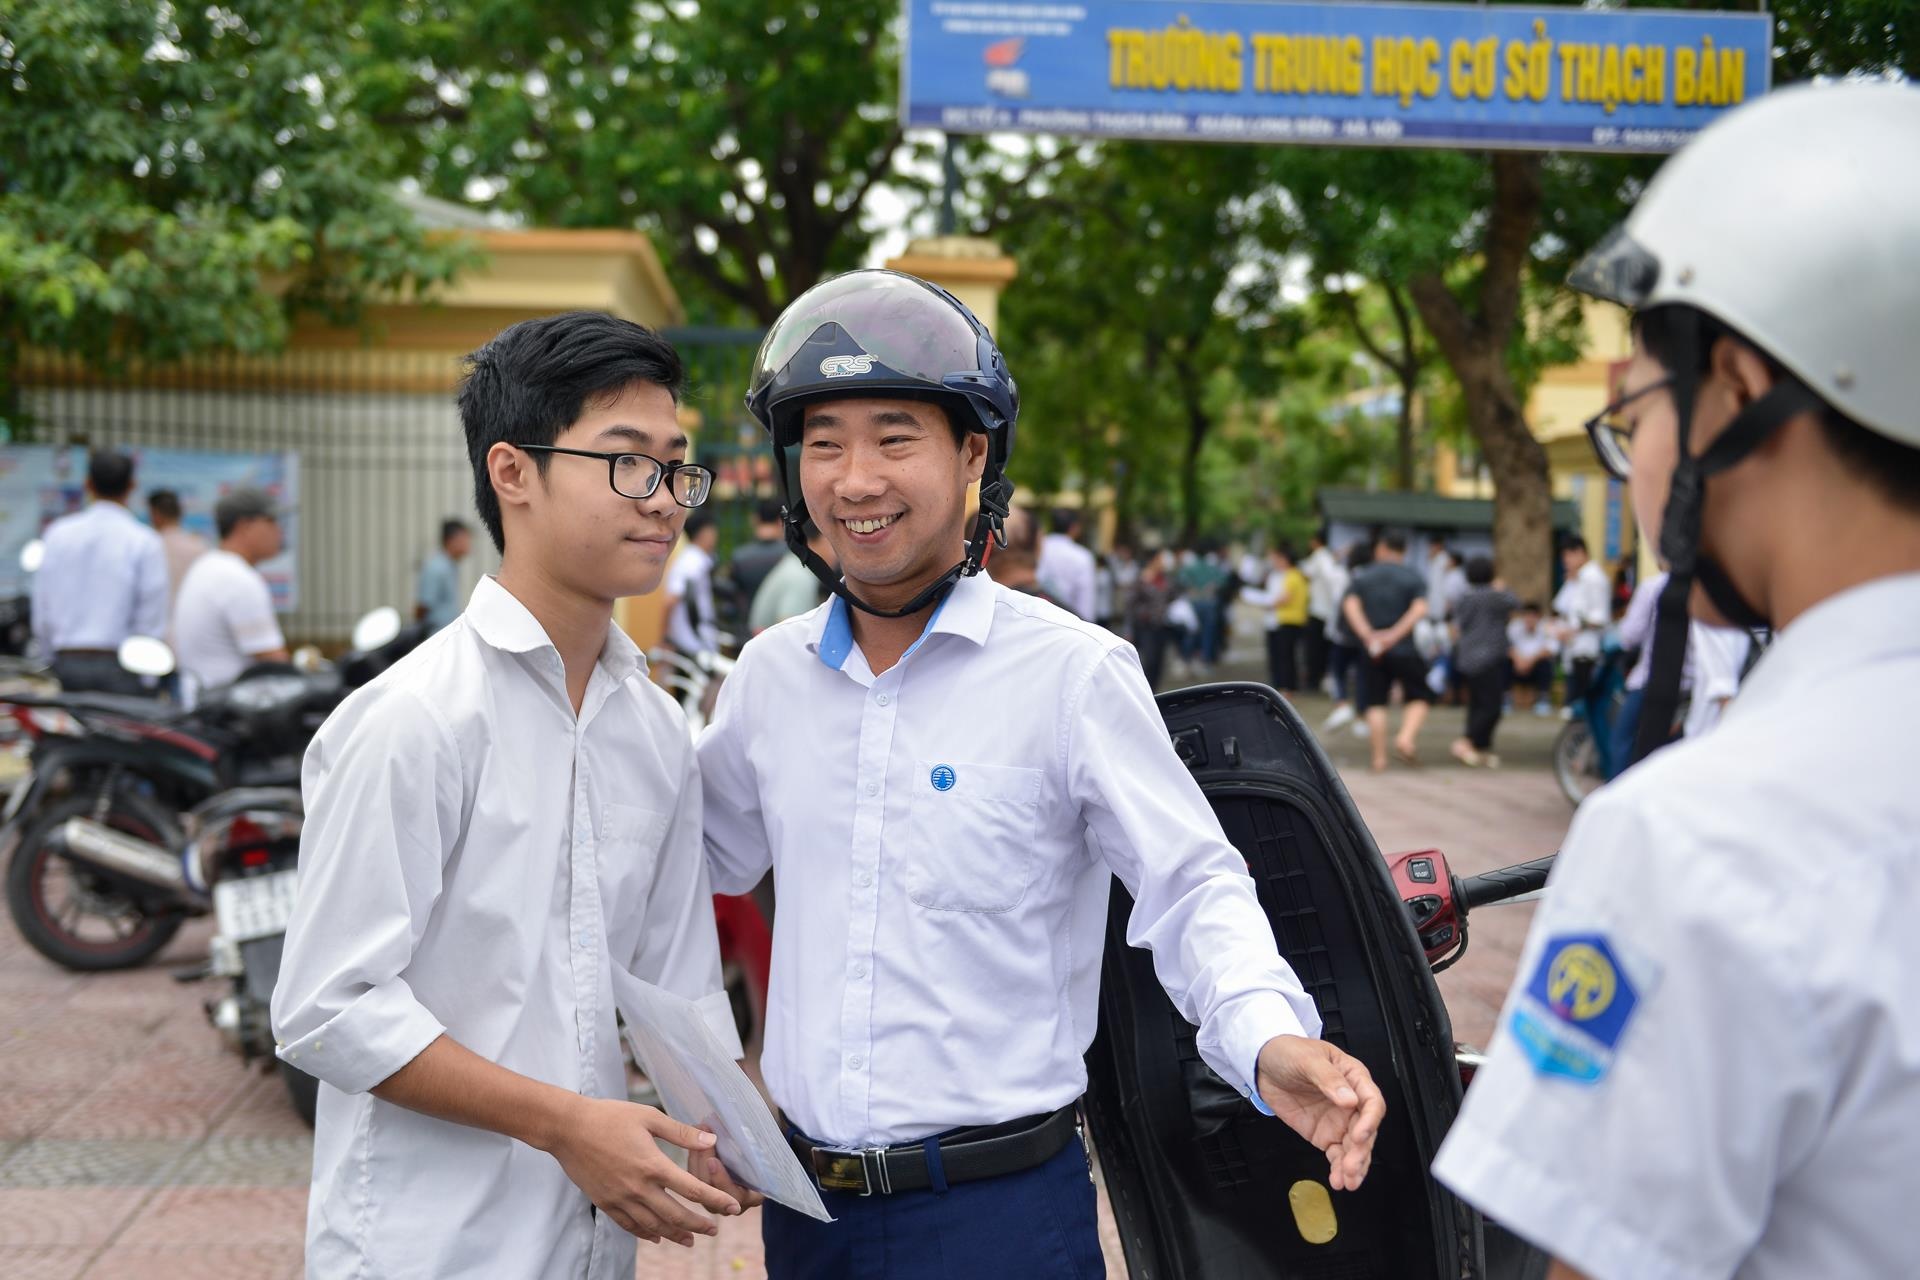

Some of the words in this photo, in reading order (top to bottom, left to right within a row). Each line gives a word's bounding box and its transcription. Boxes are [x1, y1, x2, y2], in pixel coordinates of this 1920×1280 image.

[1107, 13, 1243, 91] TRƯỜNG
[1251, 33, 1364, 95] TRUNG
[1372, 36, 1441, 107] HỌC
[1449, 37, 1499, 99] CƠ
[1505, 18, 1552, 100] SỞ
[1558, 42, 1667, 114] THẠCH
[1674, 35, 1746, 106] BÀN
[820, 355, 873, 376] GRS
